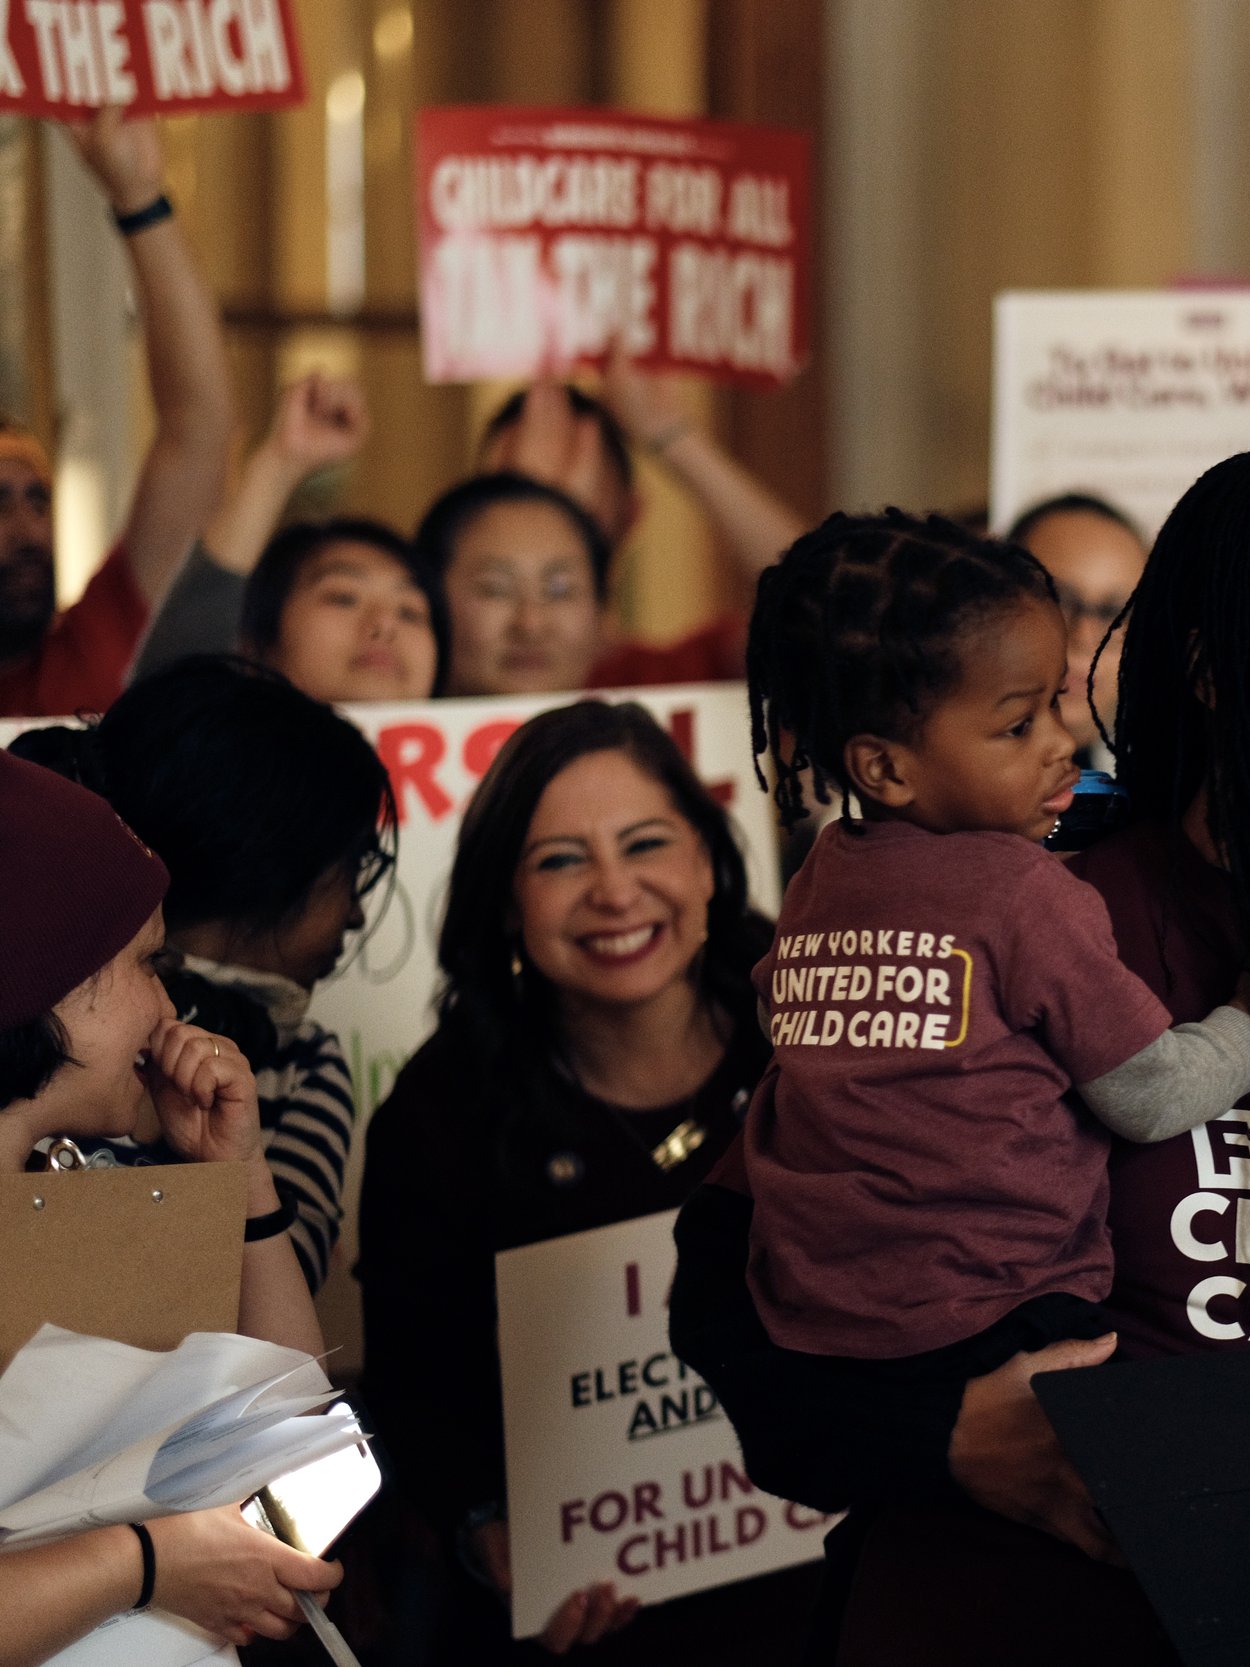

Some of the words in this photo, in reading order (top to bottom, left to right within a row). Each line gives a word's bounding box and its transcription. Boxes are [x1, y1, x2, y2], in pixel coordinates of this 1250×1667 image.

[431, 155, 640, 230] CHILDCARE
[778, 933, 824, 960] NEW
[828, 930, 956, 959] YORKERS
[772, 966, 872, 1004] UNITED
[876, 965, 952, 1005] FOR
[771, 1010, 845, 1046] CHILD
[847, 1010, 951, 1050] CARE
[627, 1385, 718, 1436] AND
[560, 1480, 663, 1544] FOR
[615, 1505, 768, 1577] CHILD
